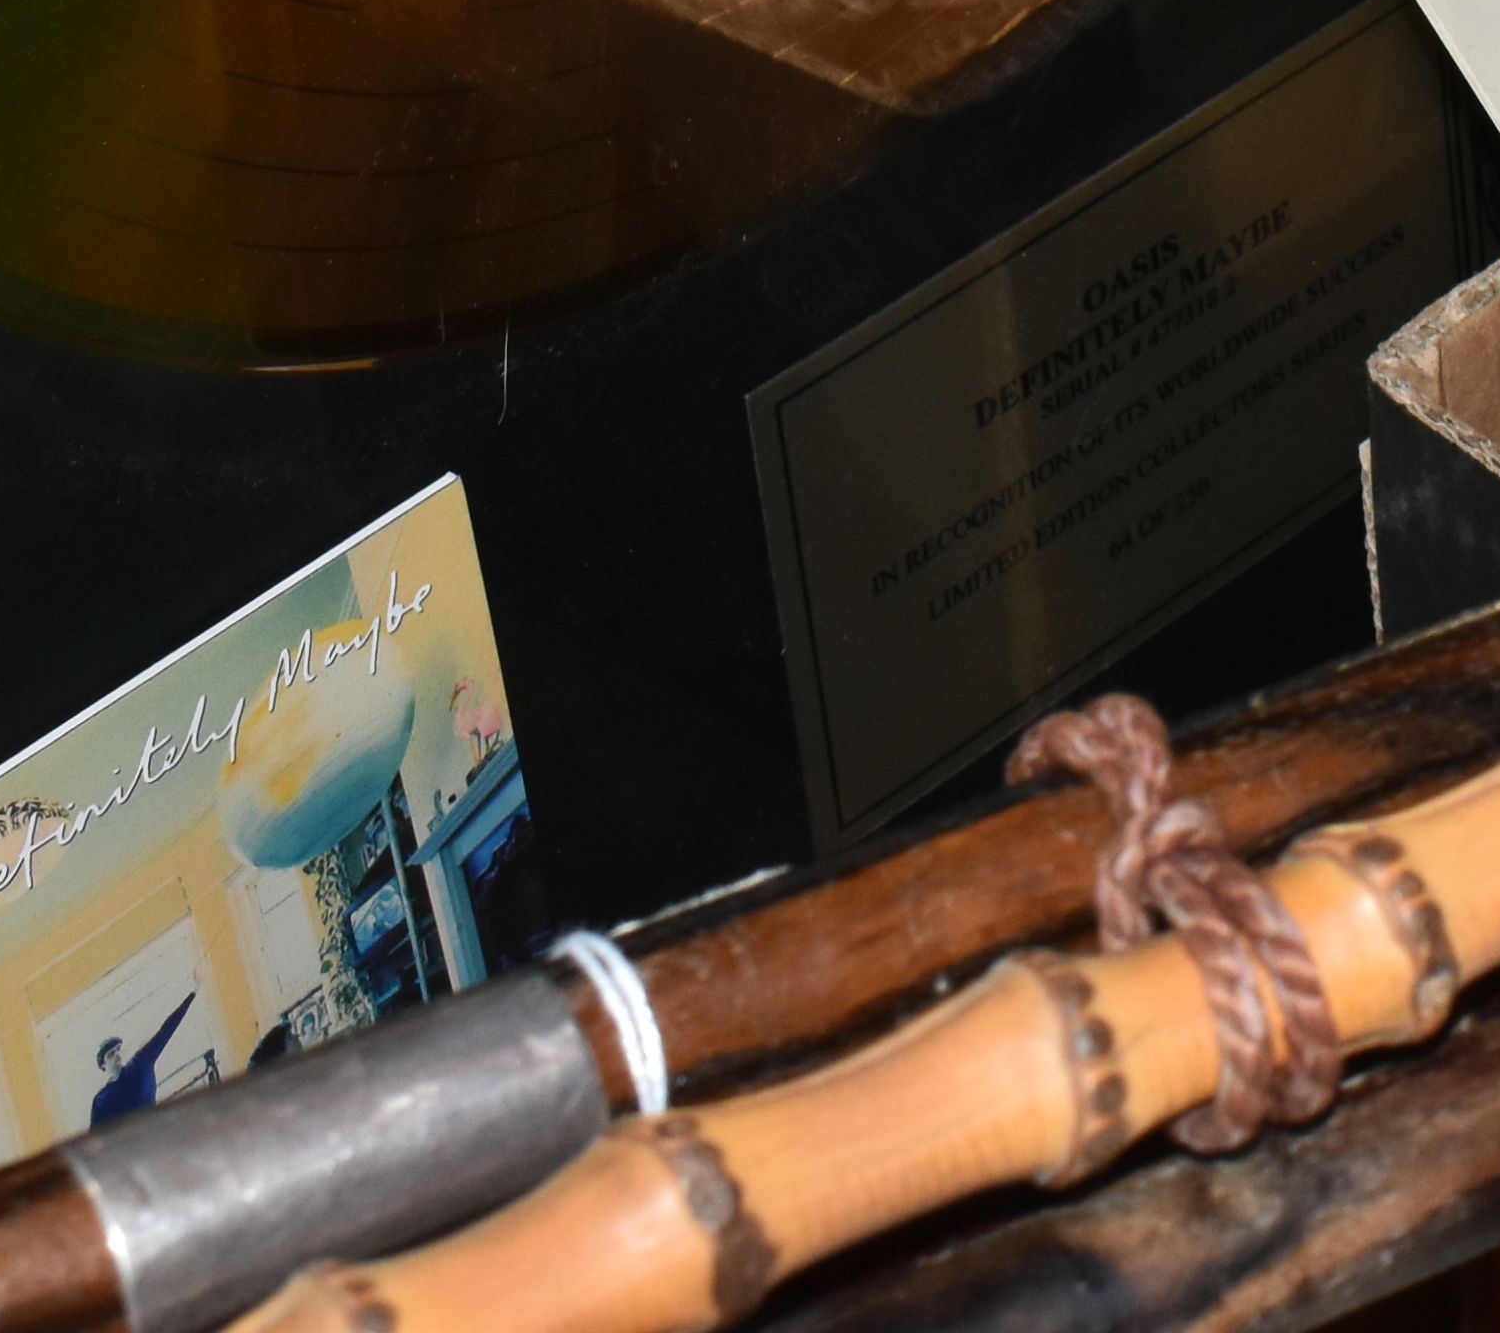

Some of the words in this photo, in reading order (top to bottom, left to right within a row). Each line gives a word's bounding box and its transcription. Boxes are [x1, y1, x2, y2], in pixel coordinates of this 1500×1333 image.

[972, 281, 1169, 429] DEFINITELY
[1177, 199, 1291, 294] MAYBE
[1082, 232, 1180, 314] OASIS
[870, 561, 899, 597] IN
[903, 443, 1073, 574] RECOGNITION
[1077, 427, 1108, 456] OF
[1113, 395, 1151, 433] ITS
[1155, 291, 1301, 403] WORLDWIDE
[1304, 222, 1406, 305] SUCCESS
[1040, 350, 1126, 419] SERIAL
[926, 537, 1030, 621] LIMITED
[1034, 466, 1132, 550] EDITION
[1135, 364, 1287, 479] COLLECTORS
[1289, 309, 1368, 376] SERIES
[1138, 499, 1167, 538] OF
[269, 571, 433, 713] Maybe
